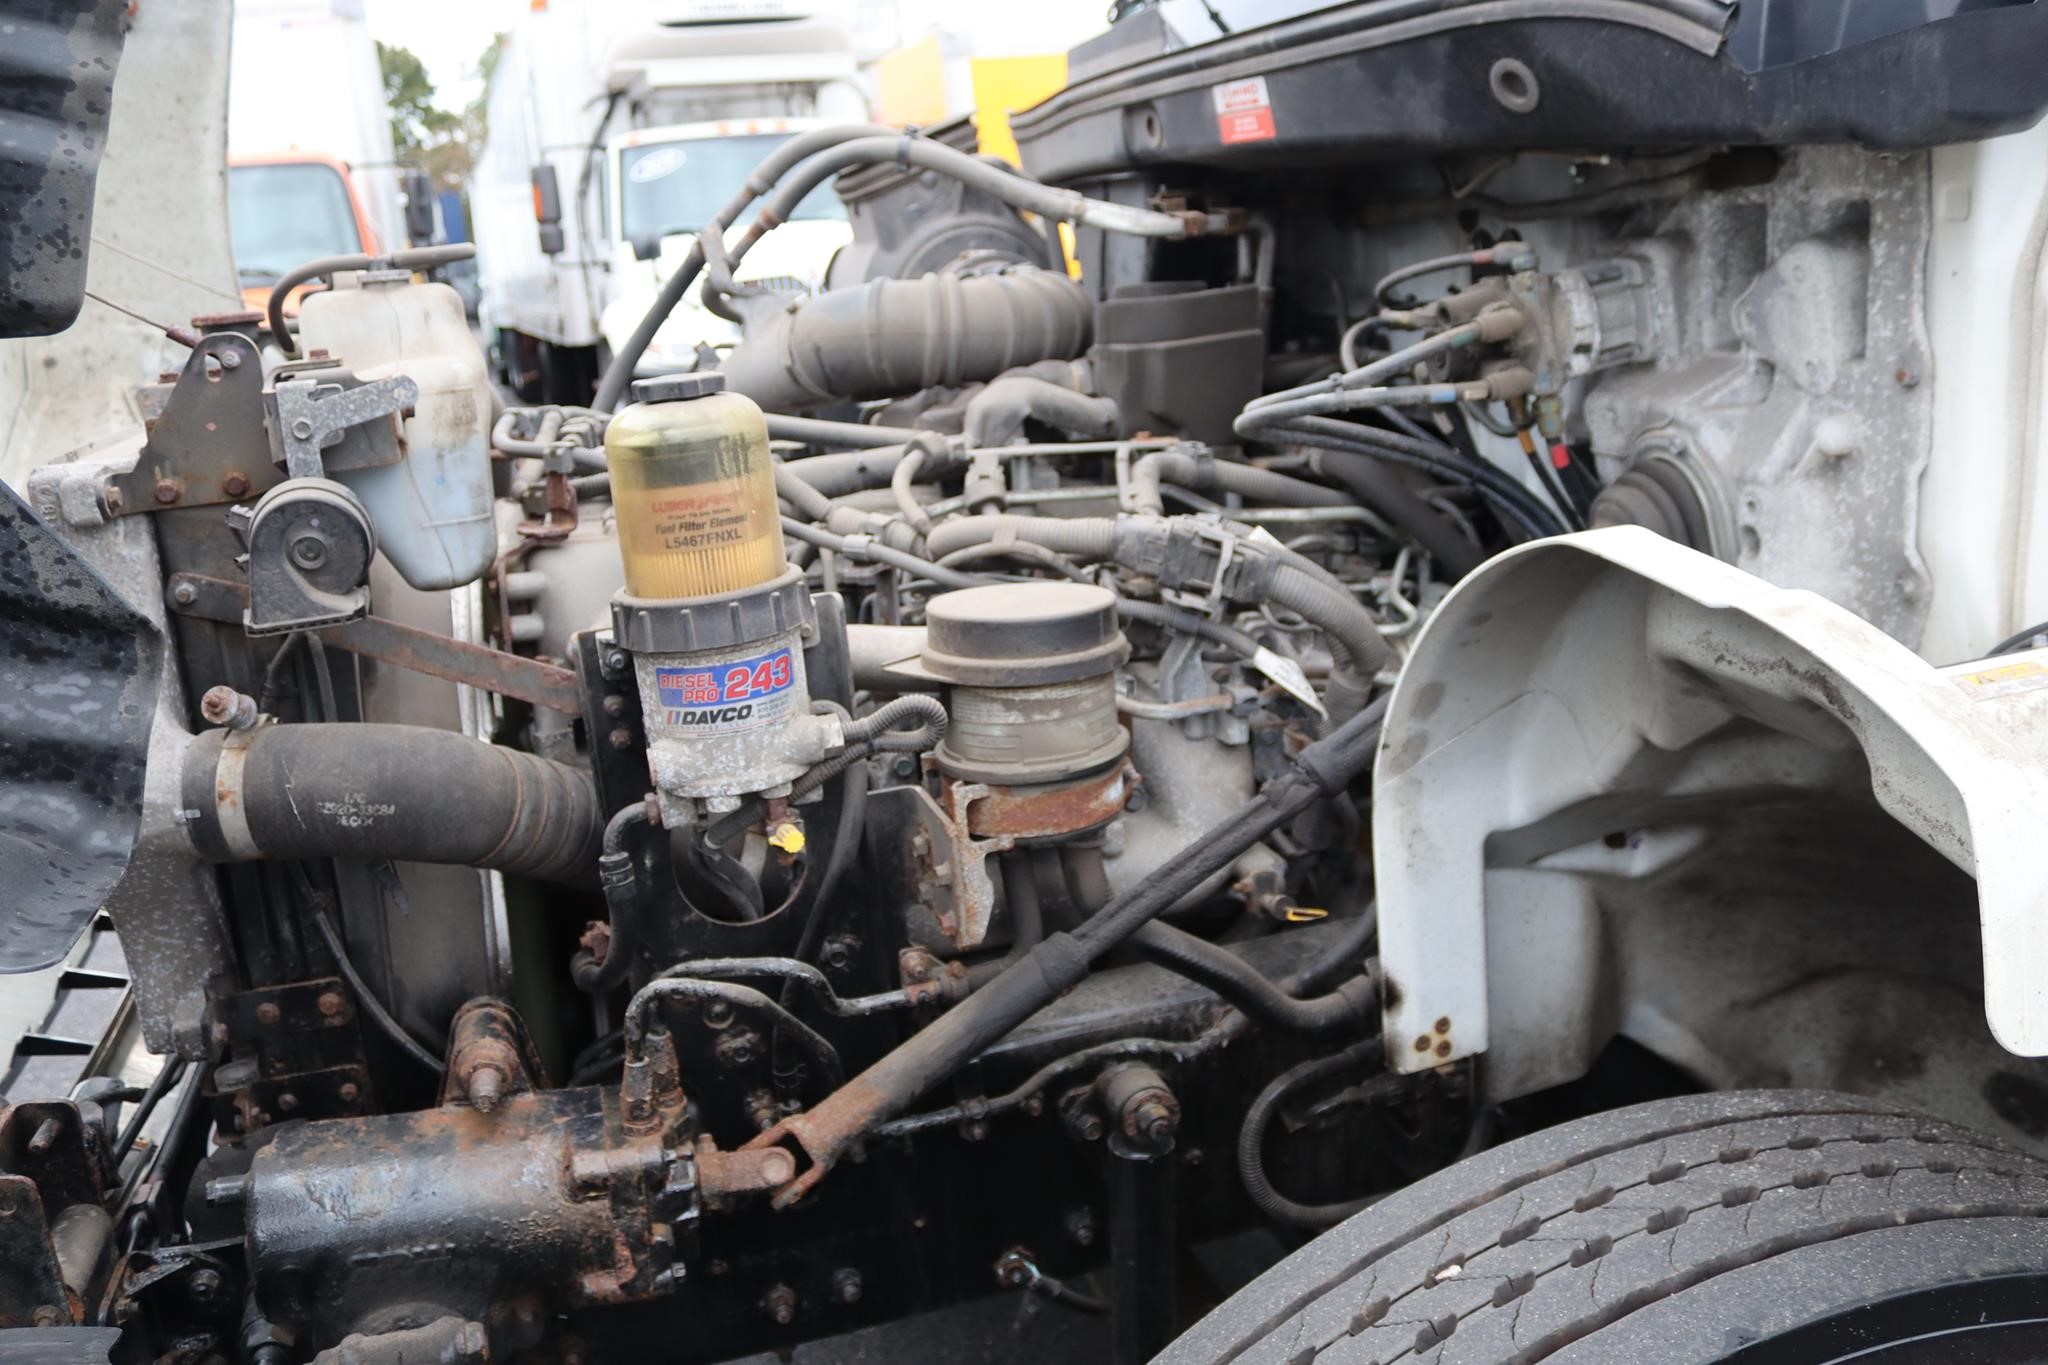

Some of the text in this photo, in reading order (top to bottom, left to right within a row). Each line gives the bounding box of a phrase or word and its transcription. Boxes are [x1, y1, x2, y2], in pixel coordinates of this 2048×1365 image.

[678, 519, 706, 533] Filter
[710, 512, 748, 529] Element
[664, 527, 743, 550] L5467FNXL
[659, 672, 717, 689] DIESEL
[724, 653, 791, 701] 243
[682, 687, 720, 704] PRO
[681, 703, 753, 726] DAVCO
